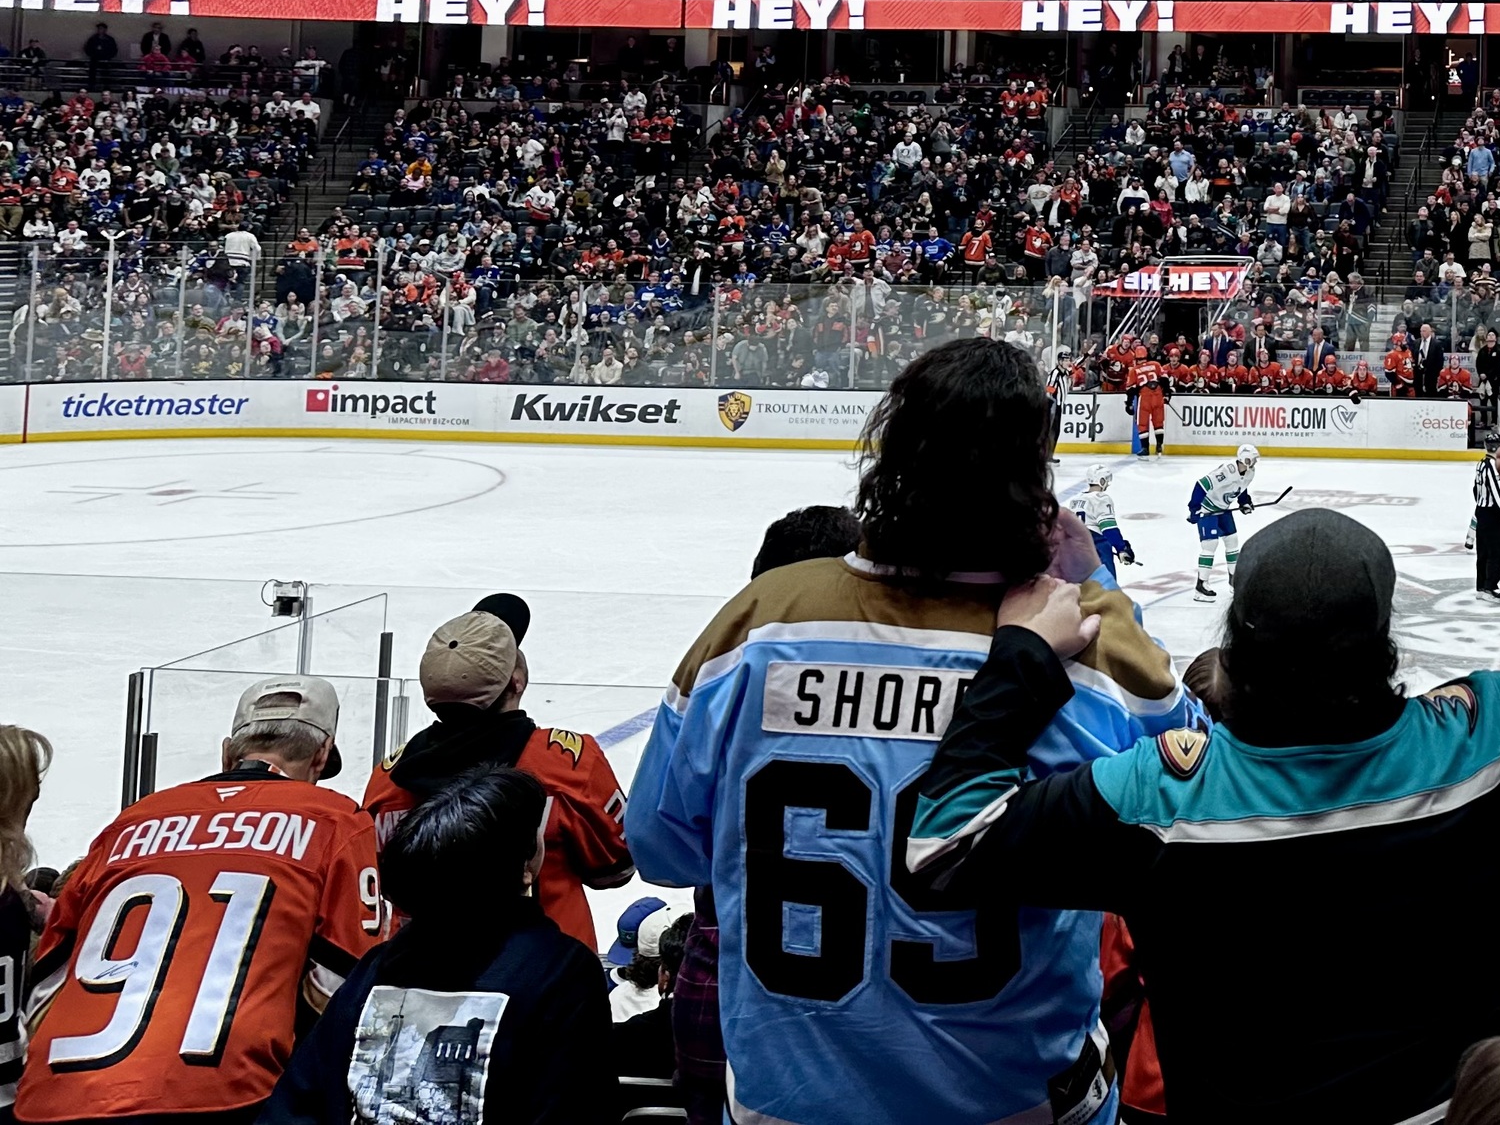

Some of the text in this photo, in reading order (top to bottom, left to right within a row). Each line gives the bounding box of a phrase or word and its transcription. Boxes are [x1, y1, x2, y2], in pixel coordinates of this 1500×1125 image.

[1020, 0, 1174, 32] HEY!
[1329, 2, 1485, 35] HEY!
[1170, 270, 1246, 292] HEY!
[62, 391, 249, 419] ticketmaster
[330, 384, 436, 419] impact
[510, 392, 682, 425] Kwikset
[756, 402, 869, 418] TROUTMAN AMIN,
[1062, 402, 1100, 419] ney
[788, 417, 821, 425] DESERVE
[1183, 405, 1326, 430] DUCKSLIVING.COM
[107, 811, 317, 865] CARLSSON
[47, 871, 274, 1073] 91
